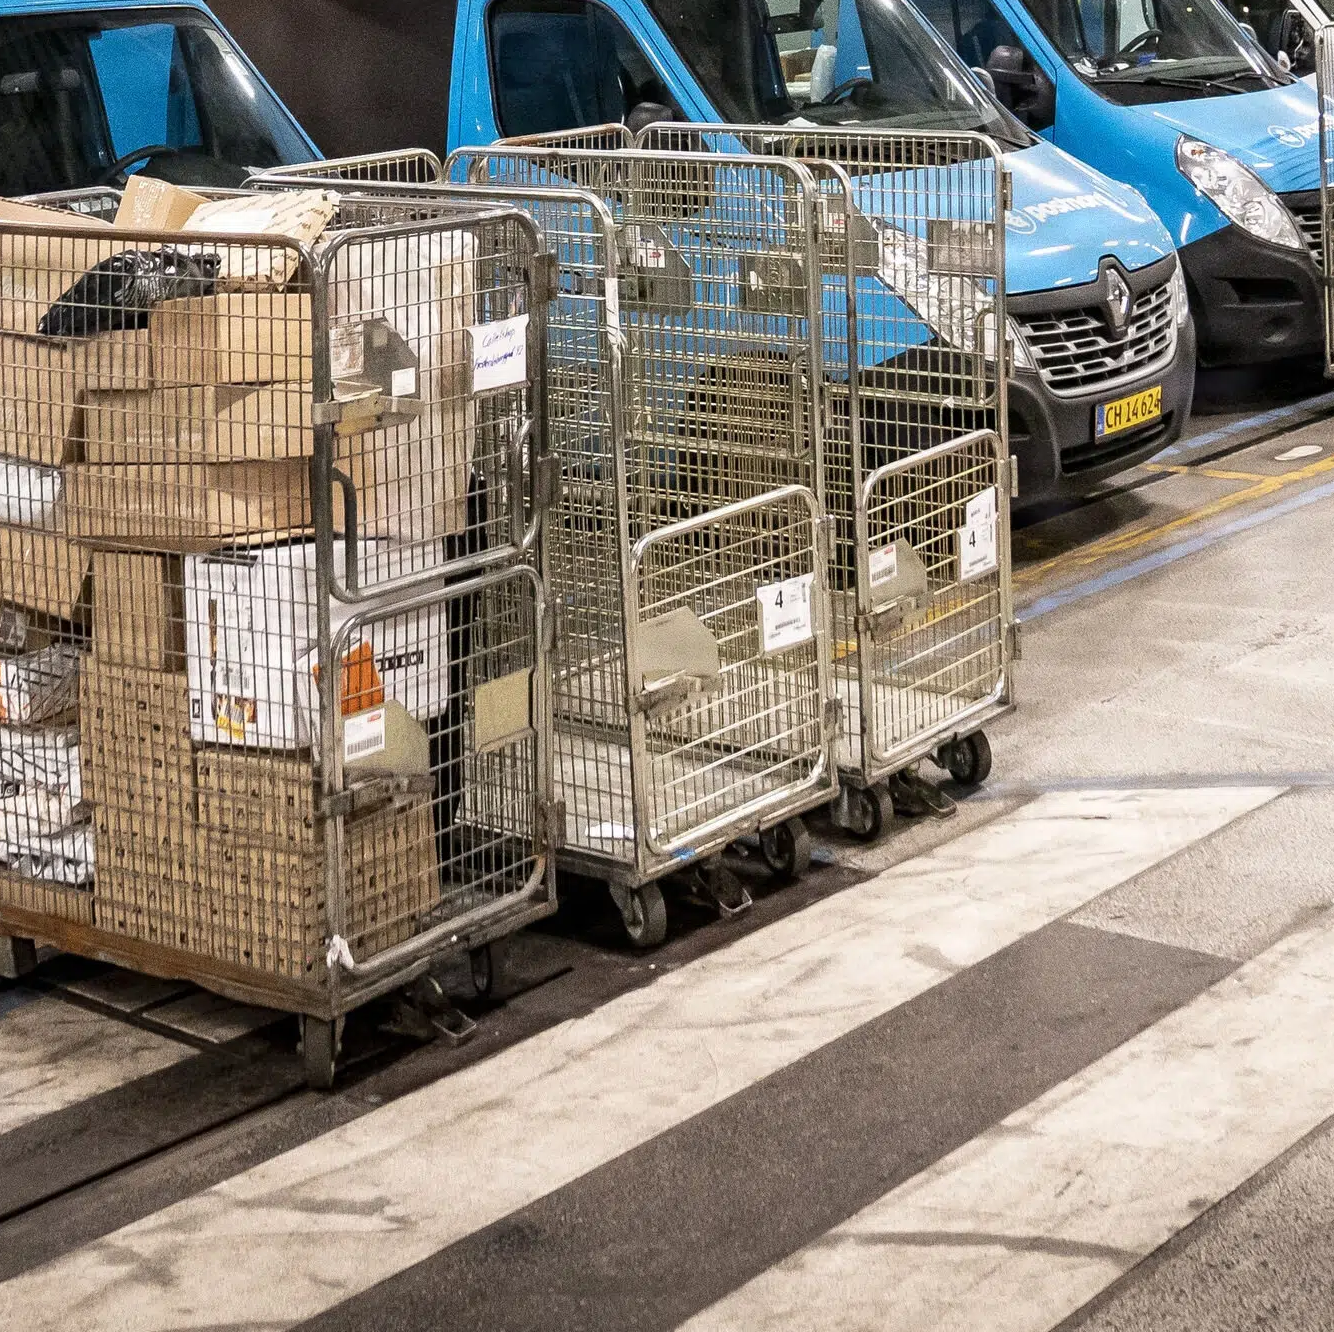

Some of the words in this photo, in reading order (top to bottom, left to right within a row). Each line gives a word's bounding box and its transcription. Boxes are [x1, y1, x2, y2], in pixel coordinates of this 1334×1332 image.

[1106, 404, 1122, 428] CH
[1126, 396, 1139, 423] 14
[1141, 389, 1161, 417] 624
[968, 530, 976, 548] 4
[775, 590, 784, 608] 4
